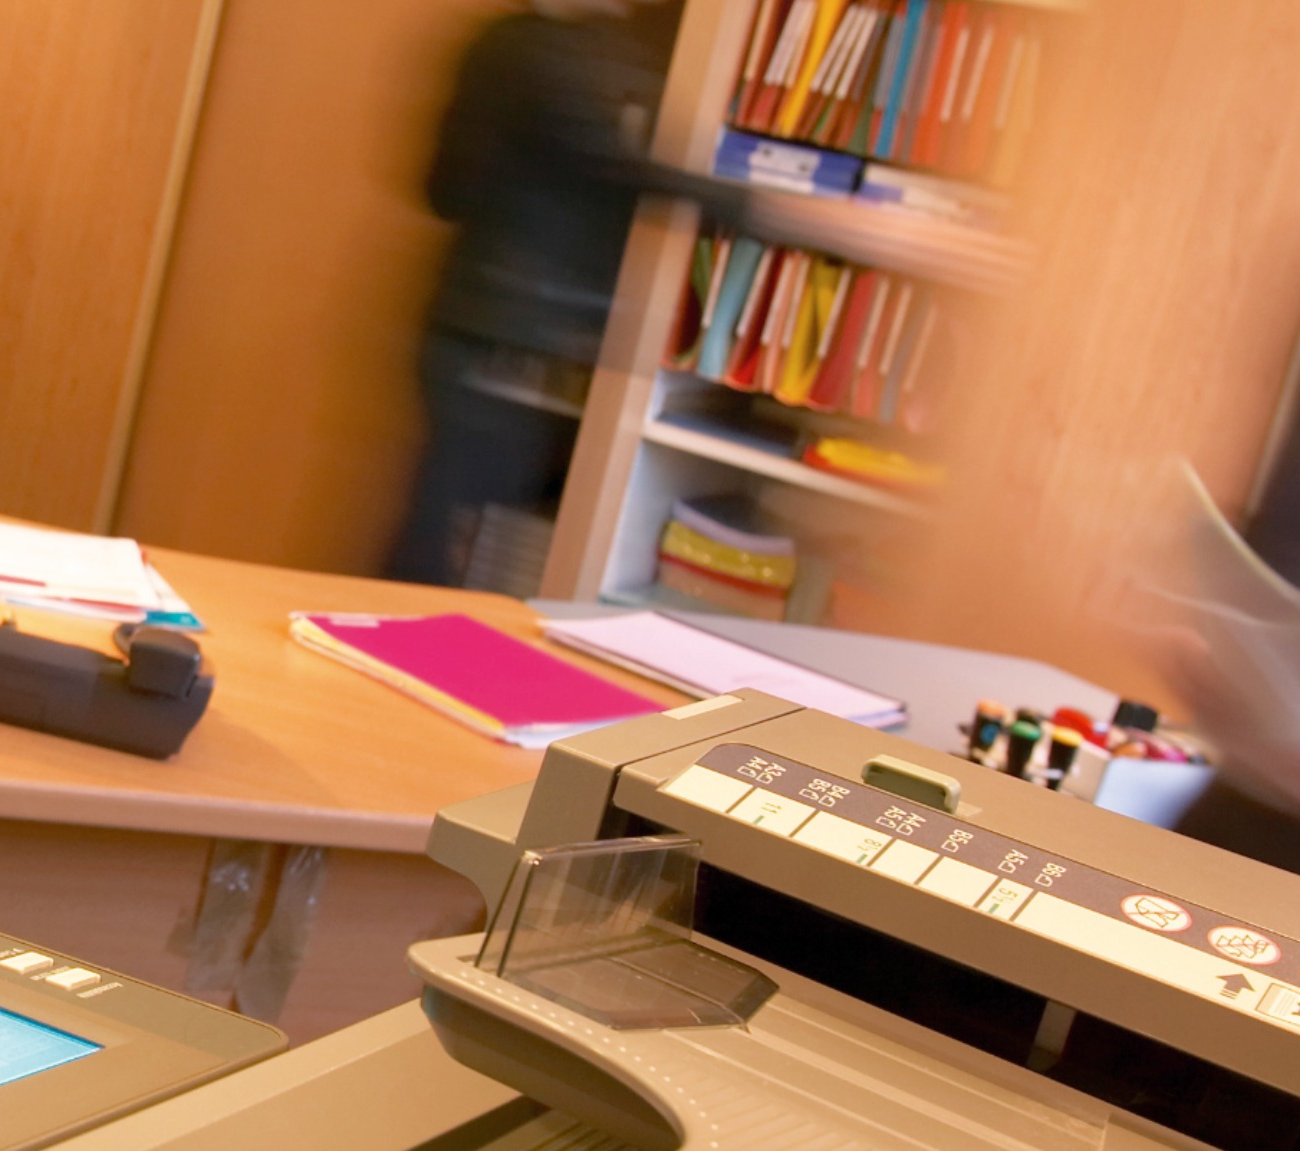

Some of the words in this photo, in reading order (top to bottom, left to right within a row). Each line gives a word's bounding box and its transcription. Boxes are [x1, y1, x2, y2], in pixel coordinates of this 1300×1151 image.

[746, 755, 768, 771] A4
[764, 762, 787, 777] A3
[808, 778, 832, 793] B5
[827, 785, 850, 800] B4
[884, 805, 907, 821] A5
[904, 812, 927, 828] A4
[949, 828, 974, 844] B5
[1005, 849, 1029, 865] A5
